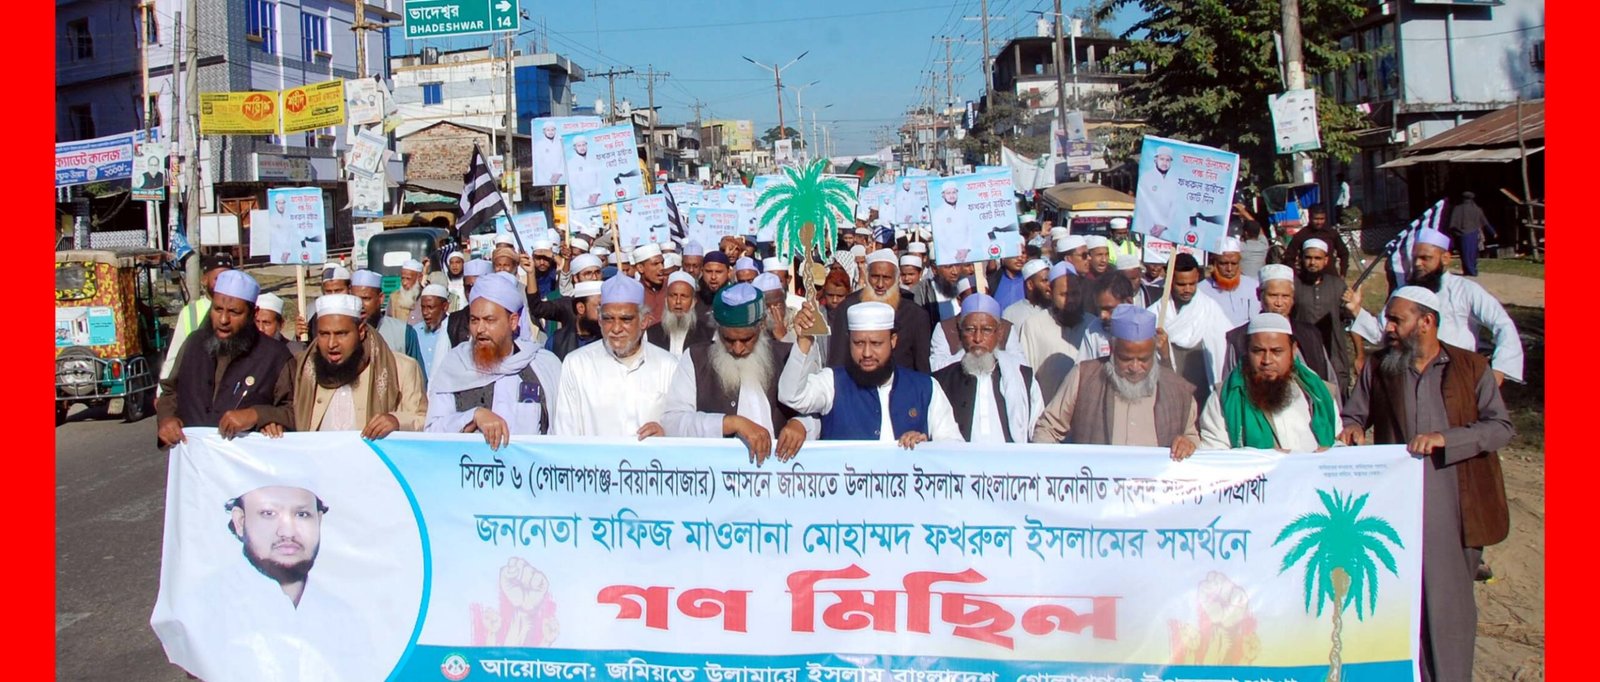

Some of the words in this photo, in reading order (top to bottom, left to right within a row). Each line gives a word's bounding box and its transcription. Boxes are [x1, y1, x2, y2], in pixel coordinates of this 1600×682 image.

[408, 4, 460, 20] ভাদেশ্বর
[496, 16, 512, 28] 14
[410, 20, 484, 34] BHADESHWAR
[460, 455, 506, 489] সিলেট
[512, 468, 523, 489] ৬
[529, 458, 716, 501] (গোলাপগঞ্জ-বিয়ানীবাজার)
[722, 468, 772, 498] আসনে
[777, 462, 840, 499] জমিয়তে
[844, 463, 909, 500] উলামায়ে
[912, 463, 966, 502] ইসলাম
[970, 471, 1041, 503] বাংলাদেশ
[1046, 465, 1109, 504] মনোনীত
[474, 511, 582, 550] জননেতা
[589, 507, 676, 551] হাফিজ
[682, 519, 793, 555] মাওলানা
[803, 522, 915, 556] মোহাম্মদ
[921, 522, 1016, 558] ফখরুল
[1025, 515, 1149, 560] ইসলামের
[1156, 515, 1251, 562] সমর্থনে
[597, 582, 753, 634] গণ
[784, 563, 1123, 651] মিছিল
[478, 657, 597, 680] আয়োজনে:
[605, 657, 699, 682] জমিয়তে
